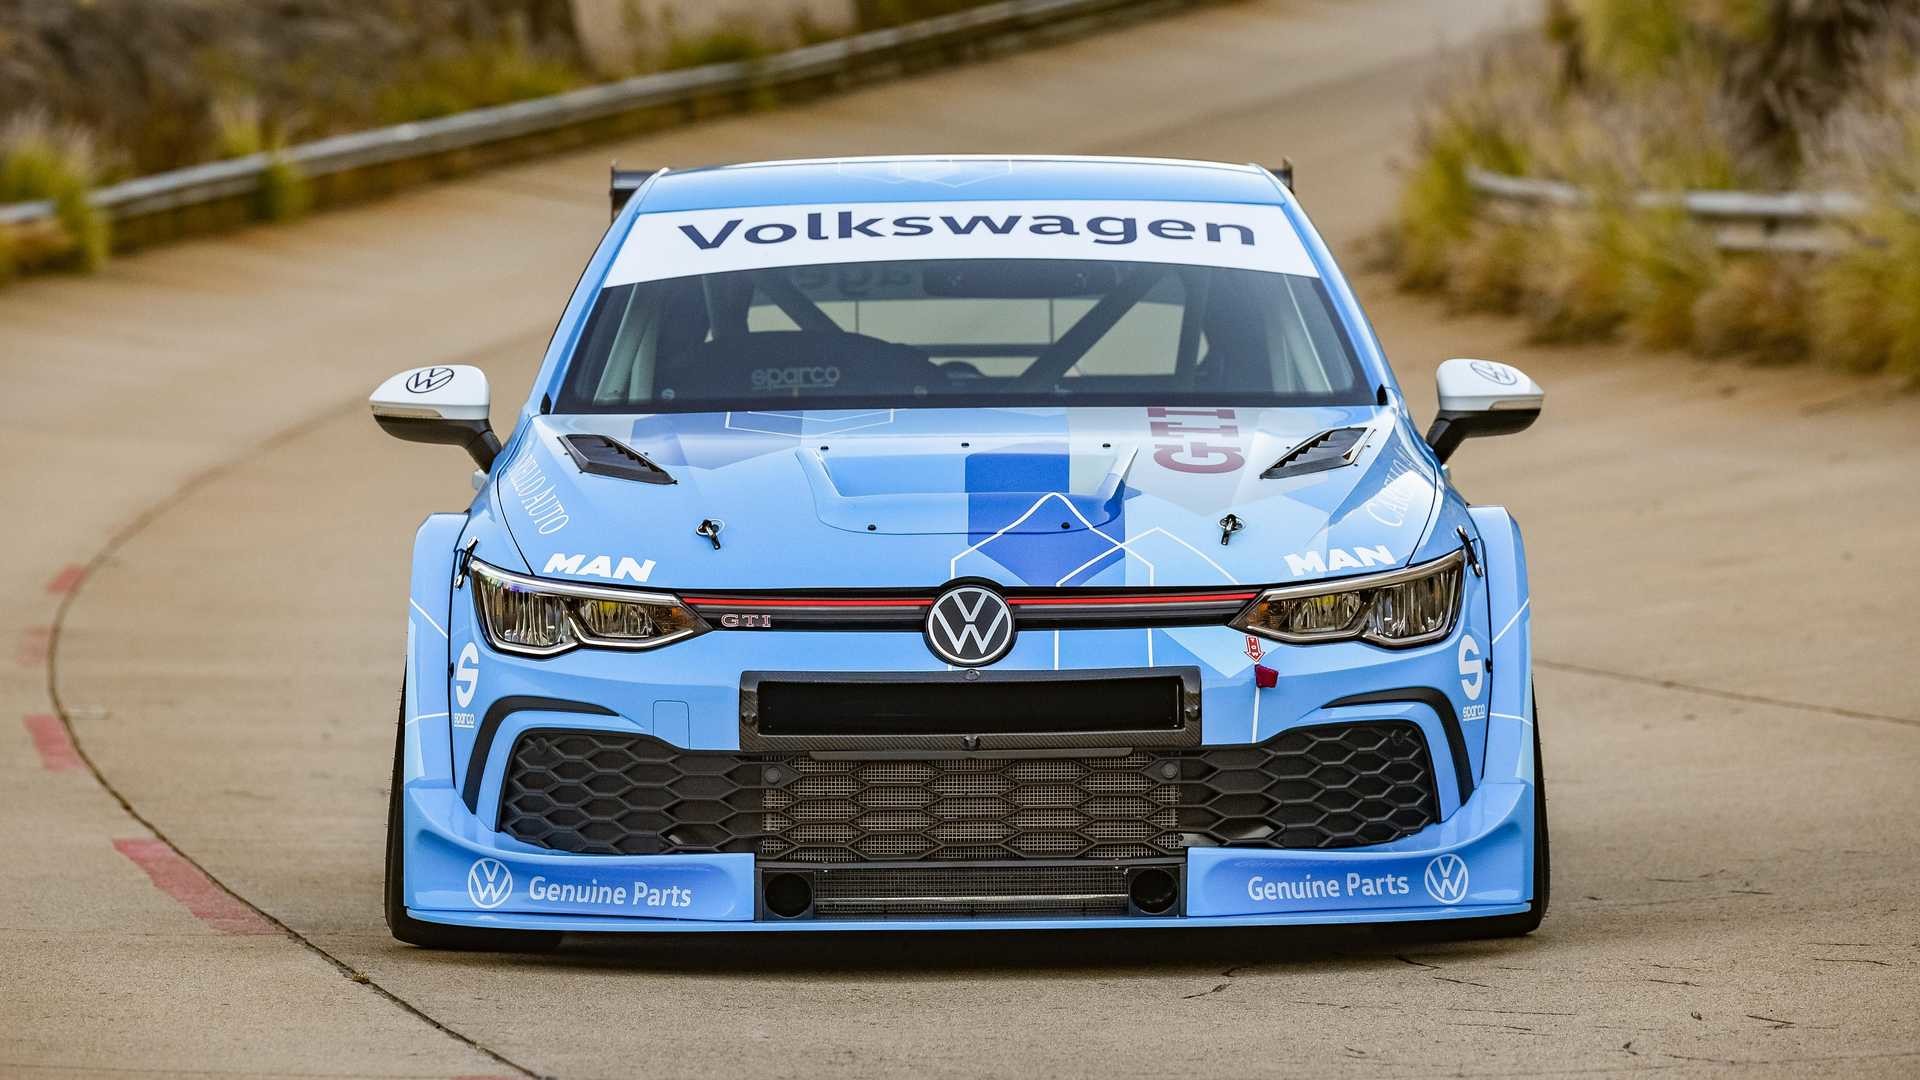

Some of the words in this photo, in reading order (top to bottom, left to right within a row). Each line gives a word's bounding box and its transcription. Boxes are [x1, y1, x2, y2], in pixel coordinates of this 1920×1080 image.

[678, 211, 1255, 250] Volkswagen
[1147, 407, 1246, 474] GTI
[543, 553, 657, 583] MAN
[1283, 544, 1397, 577] MAN
[721, 614, 772, 628] GTI
[529, 875, 627, 905] Genuine
[633, 881, 692, 907] Parts
[1248, 873, 1341, 901] Genuine
[1346, 872, 1410, 897] Parts
